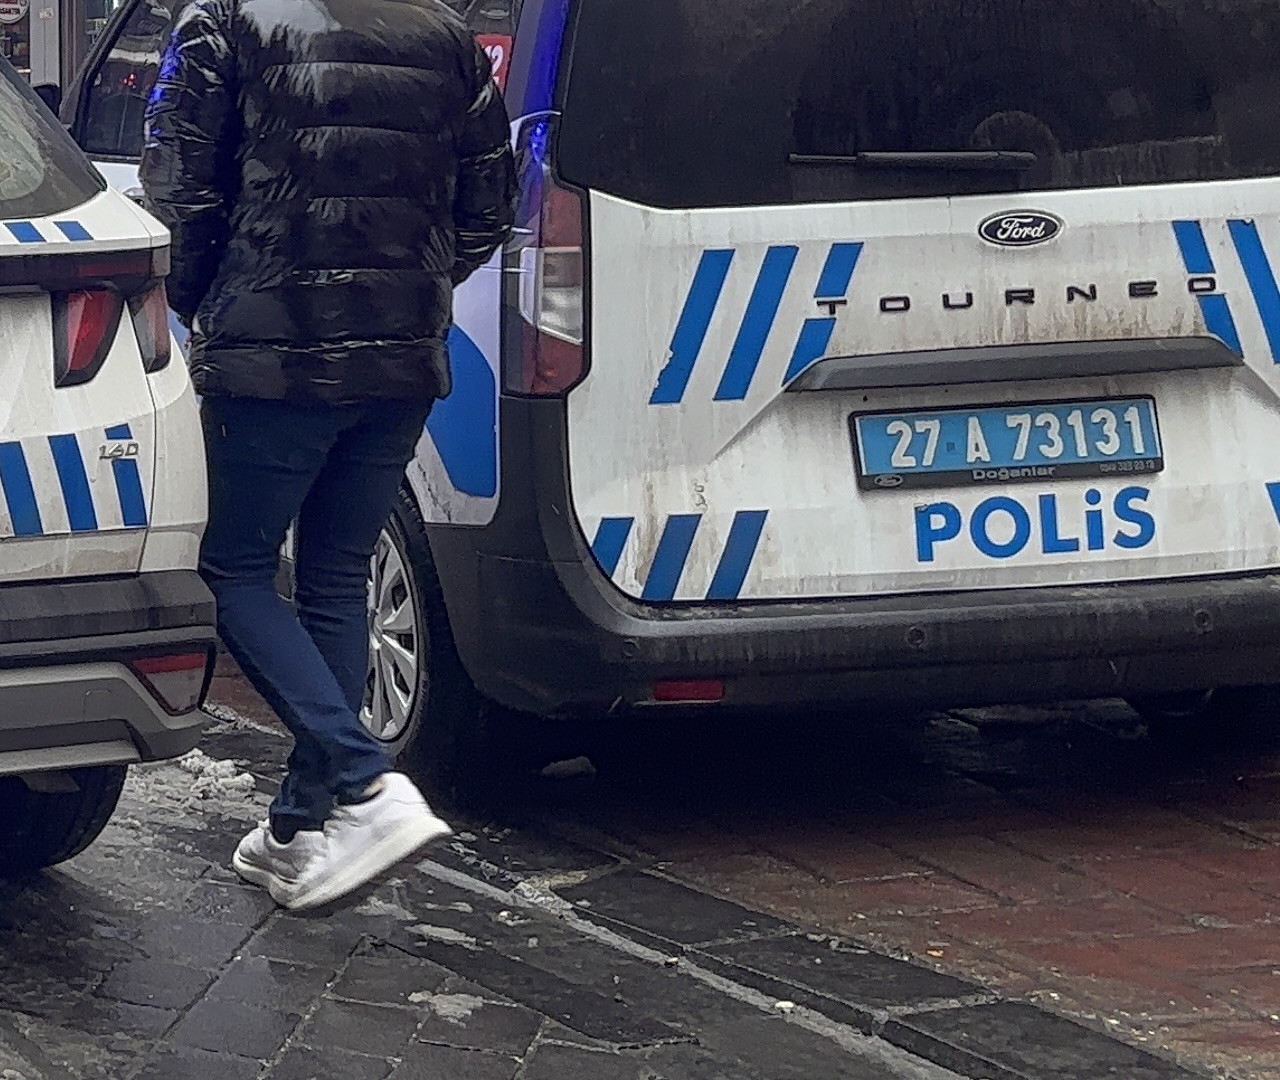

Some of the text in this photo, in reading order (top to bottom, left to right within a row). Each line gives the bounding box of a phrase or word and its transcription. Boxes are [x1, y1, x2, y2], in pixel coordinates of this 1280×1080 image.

[996, 218, 1045, 239] Ford
[816, 276, 1217, 316] TOURNEO
[886, 405, 1145, 468] 27 A 73131
[973, 466, 1057, 481] Doğanlar
